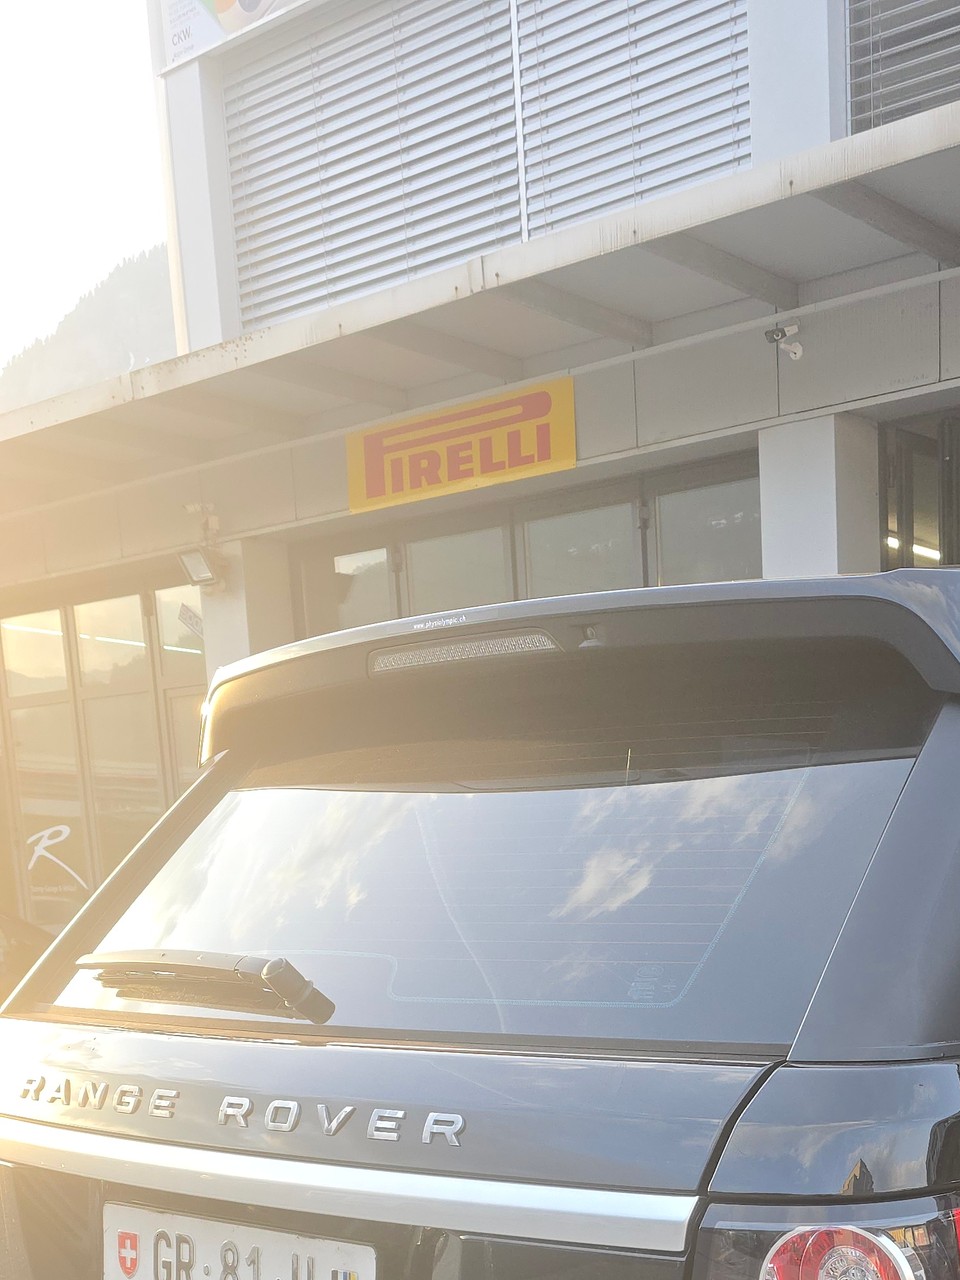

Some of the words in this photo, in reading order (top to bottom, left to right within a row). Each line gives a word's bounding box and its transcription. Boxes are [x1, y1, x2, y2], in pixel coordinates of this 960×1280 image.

[363, 390, 552, 500] PIRELLI
[19, 1075, 181, 1118] RANGE
[217, 1095, 467, 1147] ROVER
